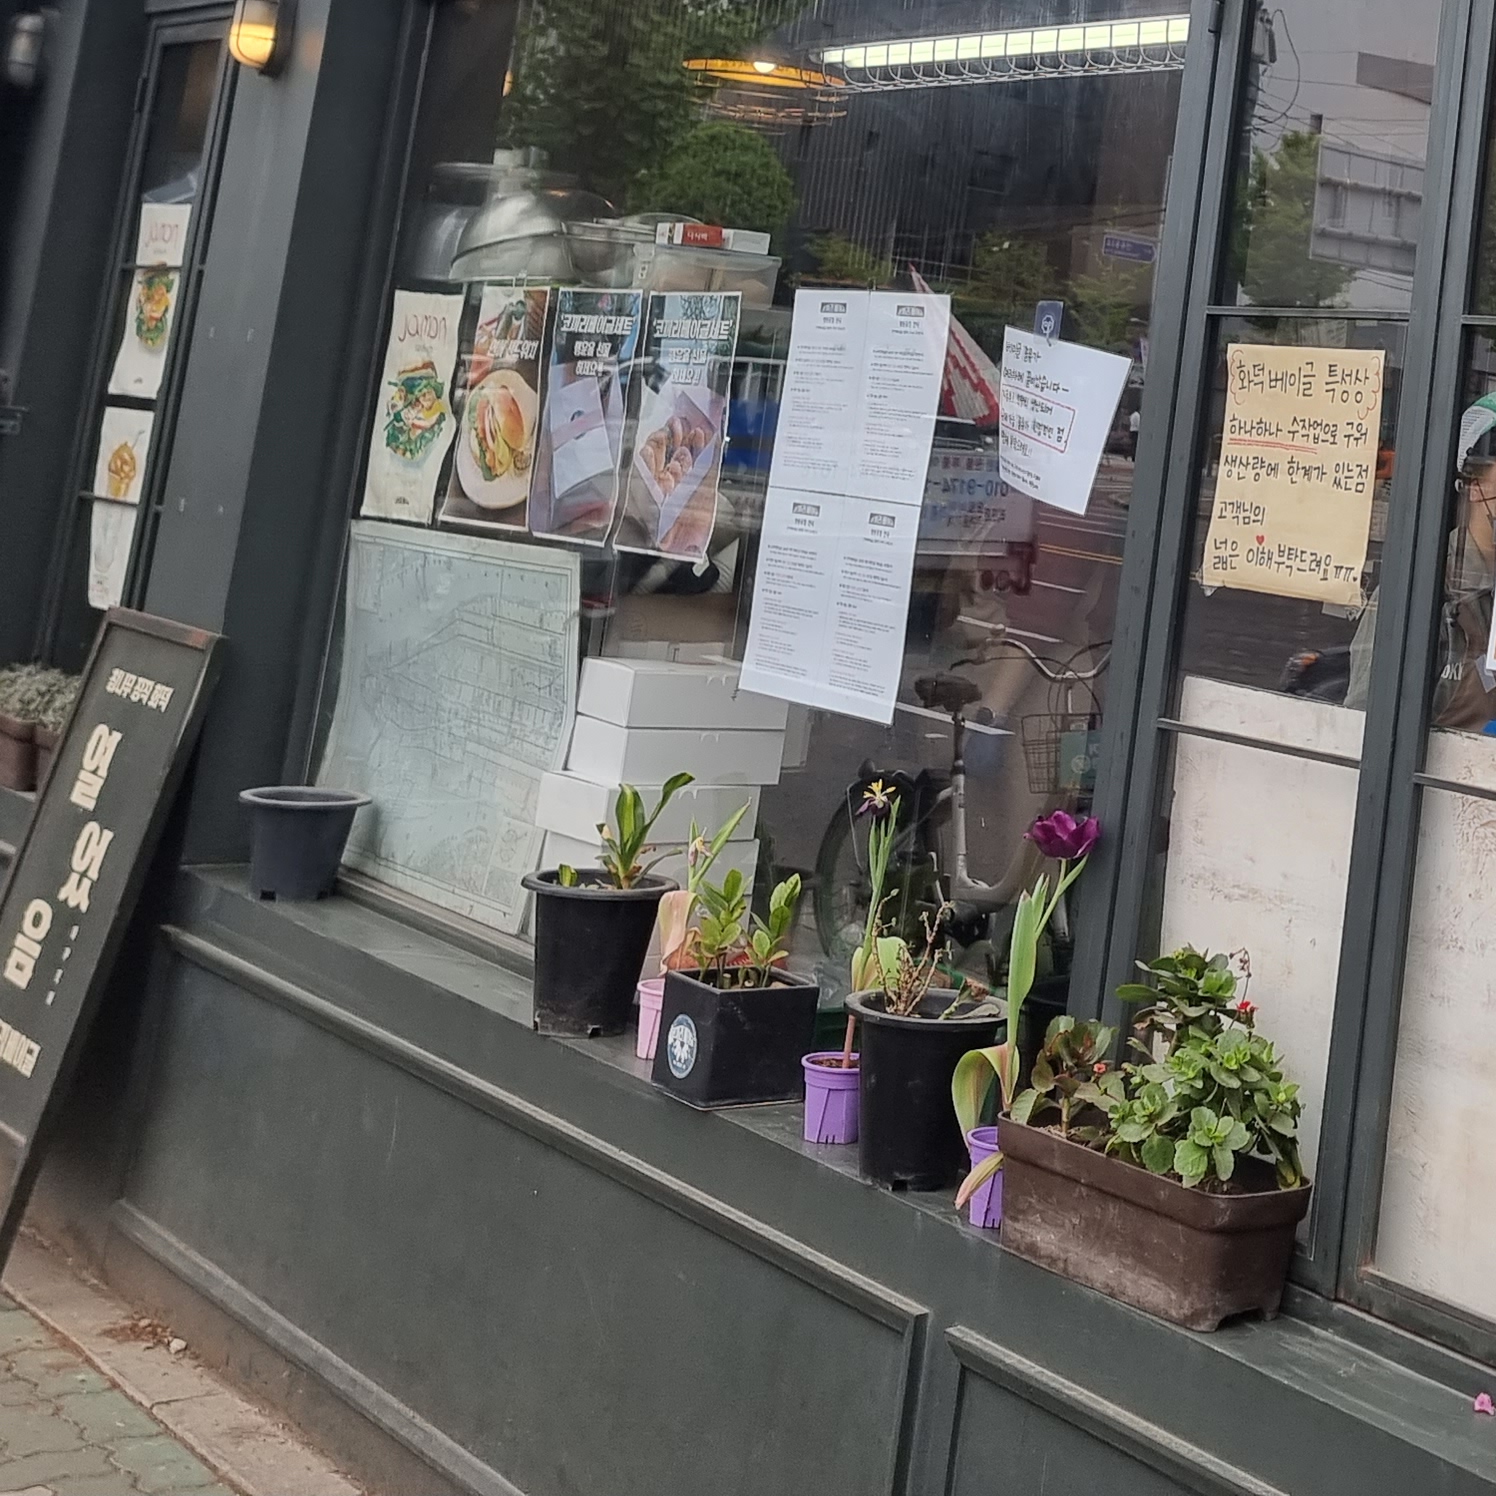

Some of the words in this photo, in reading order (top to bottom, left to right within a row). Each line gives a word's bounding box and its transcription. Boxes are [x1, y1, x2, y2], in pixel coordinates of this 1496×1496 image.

[1325, 363, 1370, 404] 특성상
[1229, 414, 1283, 439] 하나하나
[1288, 416, 1339, 446] 수작업으로
[1343, 421, 1369, 448] 구워
[1224, 455, 1280, 482] 생산량에
[1287, 455, 1327, 484] 한계가
[1217, 501, 1266, 526] 고객님의
